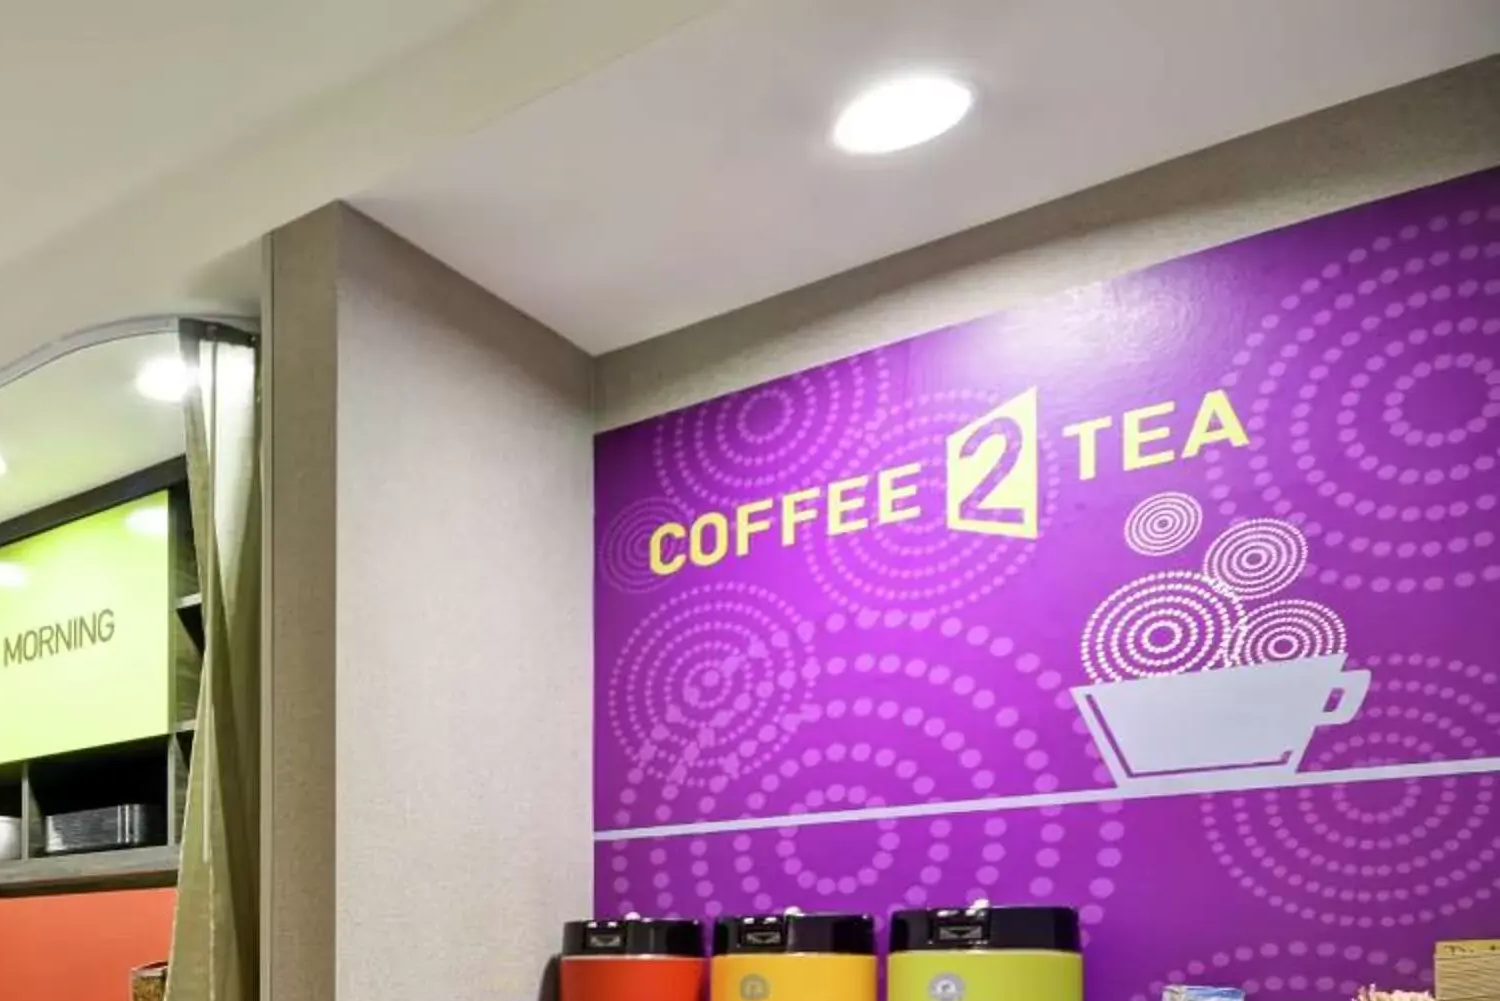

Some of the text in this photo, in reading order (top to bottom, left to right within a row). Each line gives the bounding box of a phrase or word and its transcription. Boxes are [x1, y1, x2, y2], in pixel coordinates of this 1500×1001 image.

[648, 389, 1251, 576] COFFEE 2 TEA
[3, 608, 115, 668] MORNING
